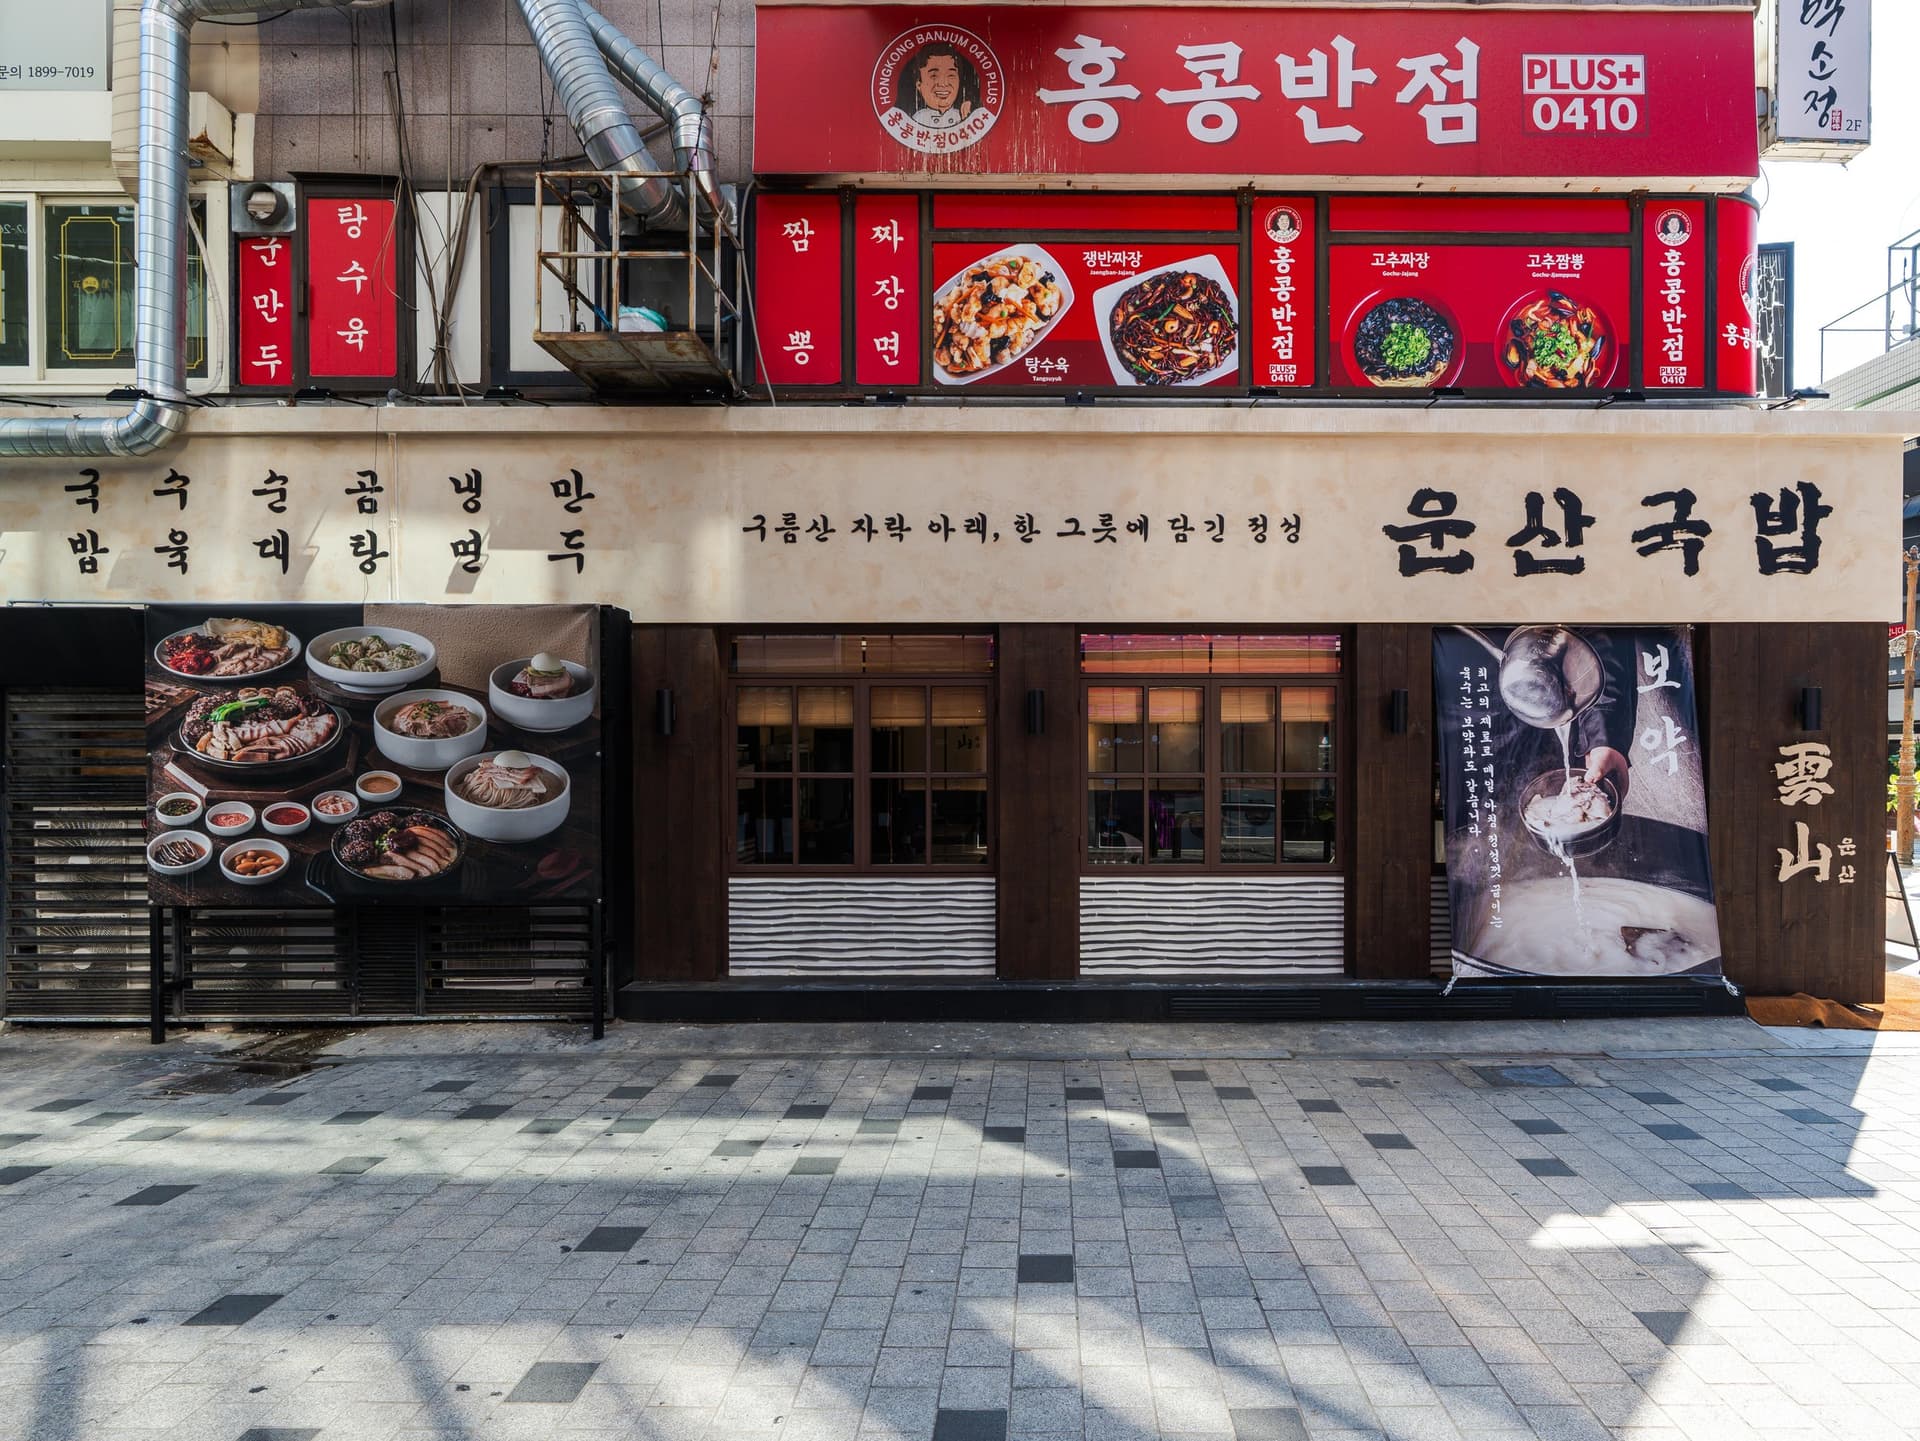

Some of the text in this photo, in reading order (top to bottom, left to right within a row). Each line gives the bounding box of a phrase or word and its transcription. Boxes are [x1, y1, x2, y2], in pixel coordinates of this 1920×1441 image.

[28, 66, 95, 78] 1899-7019
[879, 31, 999, 105] HONGKONG BANJUM 0410 PLUS
[1036, 34, 1480, 144] 홍콩반점
[1526, 58, 1641, 90] PLUS+
[1532, 97, 1638, 131] 0410
[1846, 119, 1862, 131] 2F
[336, 203, 369, 353] 탕수육
[1082, 250, 1143, 268] 쟁반짜장
[1371, 251, 1430, 269] 고추짜장
[1526, 253, 1585, 270] 고추짬뽕
[251, 237, 284, 380] 군만두
[781, 218, 815, 366] 짬뽕
[870, 219, 904, 367] 짜장면
[1269, 246, 1297, 360] 홍콩반점
[1659, 249, 1687, 362] 홍콩반점
[1025, 356, 1069, 374] 탕수육
[1271, 374, 1295, 383] 0410
[1661, 375, 1685, 384] 0410
[742, 512, 1301, 545] 구름산 자락 아래, 한 그릇에 담긴 정성
[1459, 666, 1473, 709] 육수는
[1477, 667, 1490, 709] 최고의
[1637, 644, 1687, 776] 보약
[1462, 716, 1477, 771] 보약과도
[1483, 763, 1494, 792] 매일
[1484, 799, 1497, 828] 아침
[1774, 742, 1835, 883] 雲山
[1488, 833, 1501, 878] 정성껏
[1837, 837, 1856, 884] 운산
